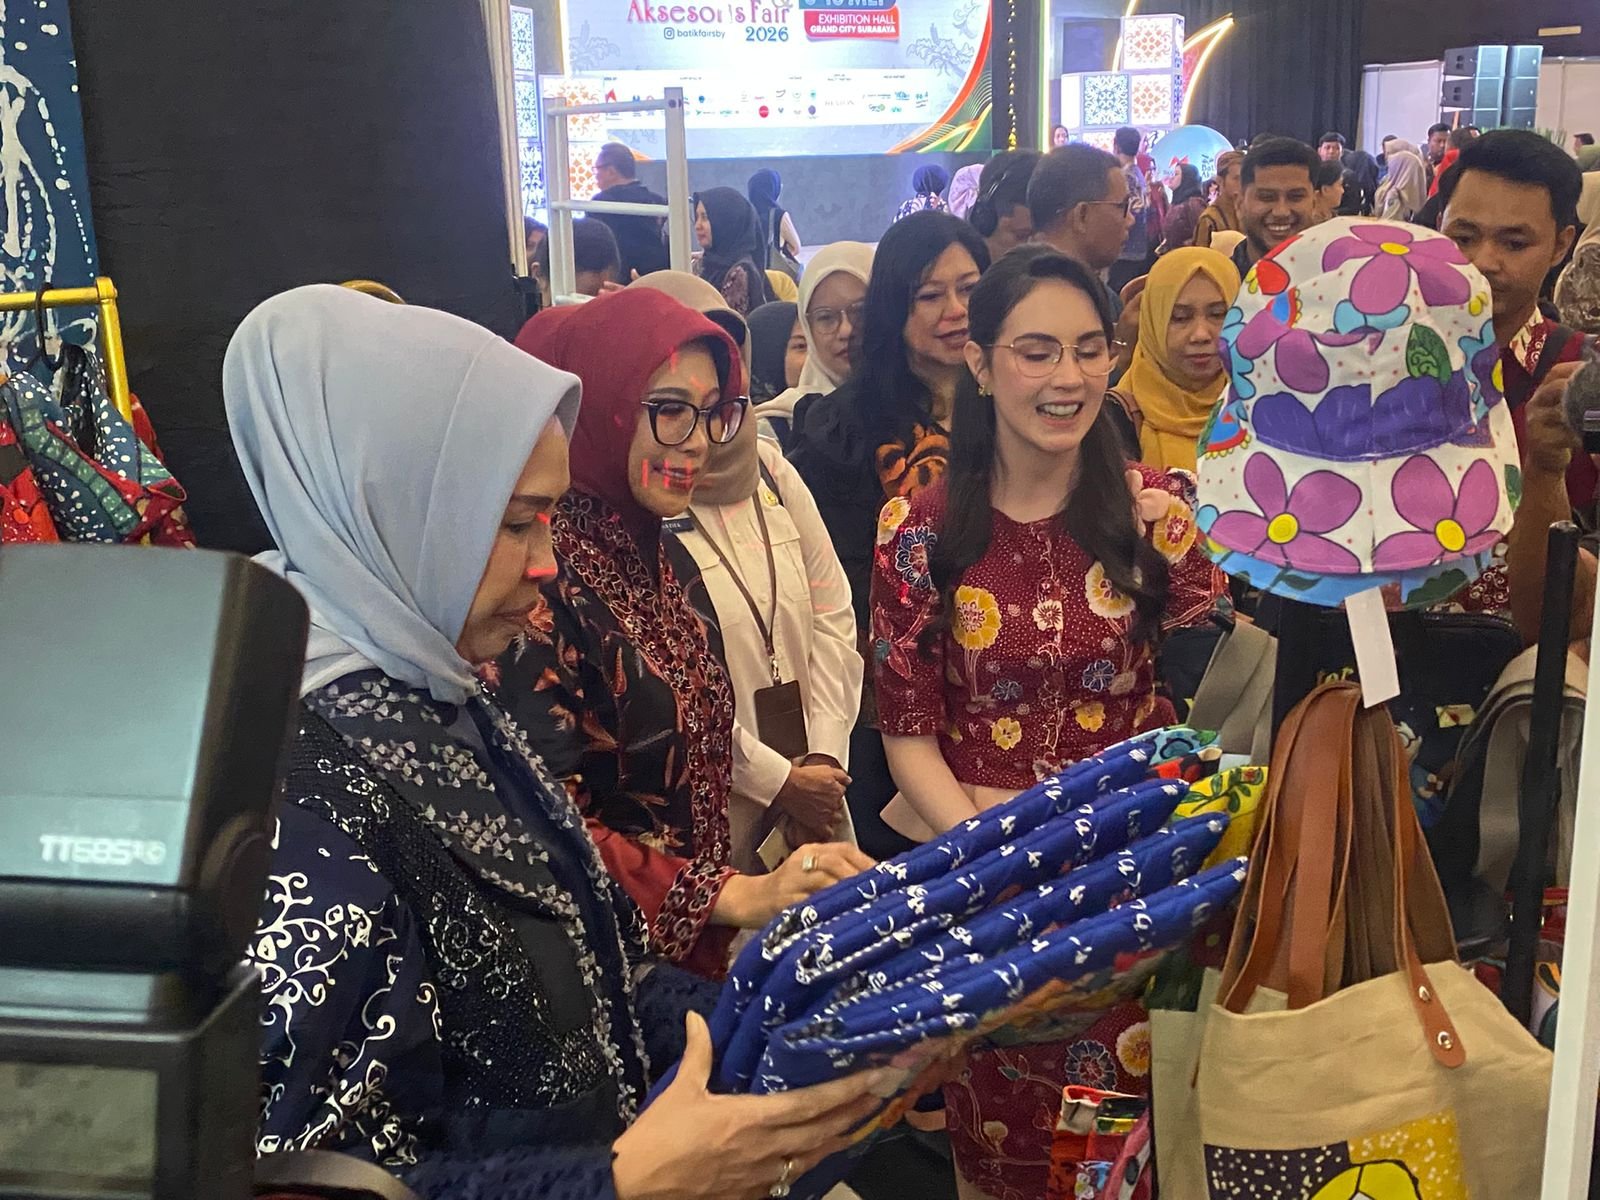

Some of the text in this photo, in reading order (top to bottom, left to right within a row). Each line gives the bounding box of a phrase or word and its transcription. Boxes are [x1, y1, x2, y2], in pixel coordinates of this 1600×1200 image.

[750, 0, 790, 24] Fair
[818, 13, 896, 25] EXHIBITION HALL
[676, 29, 726, 39] batikfairsby
[745, 26, 789, 42] 2026
[810, 25, 896, 33] GRAND CITY SURABAYA
